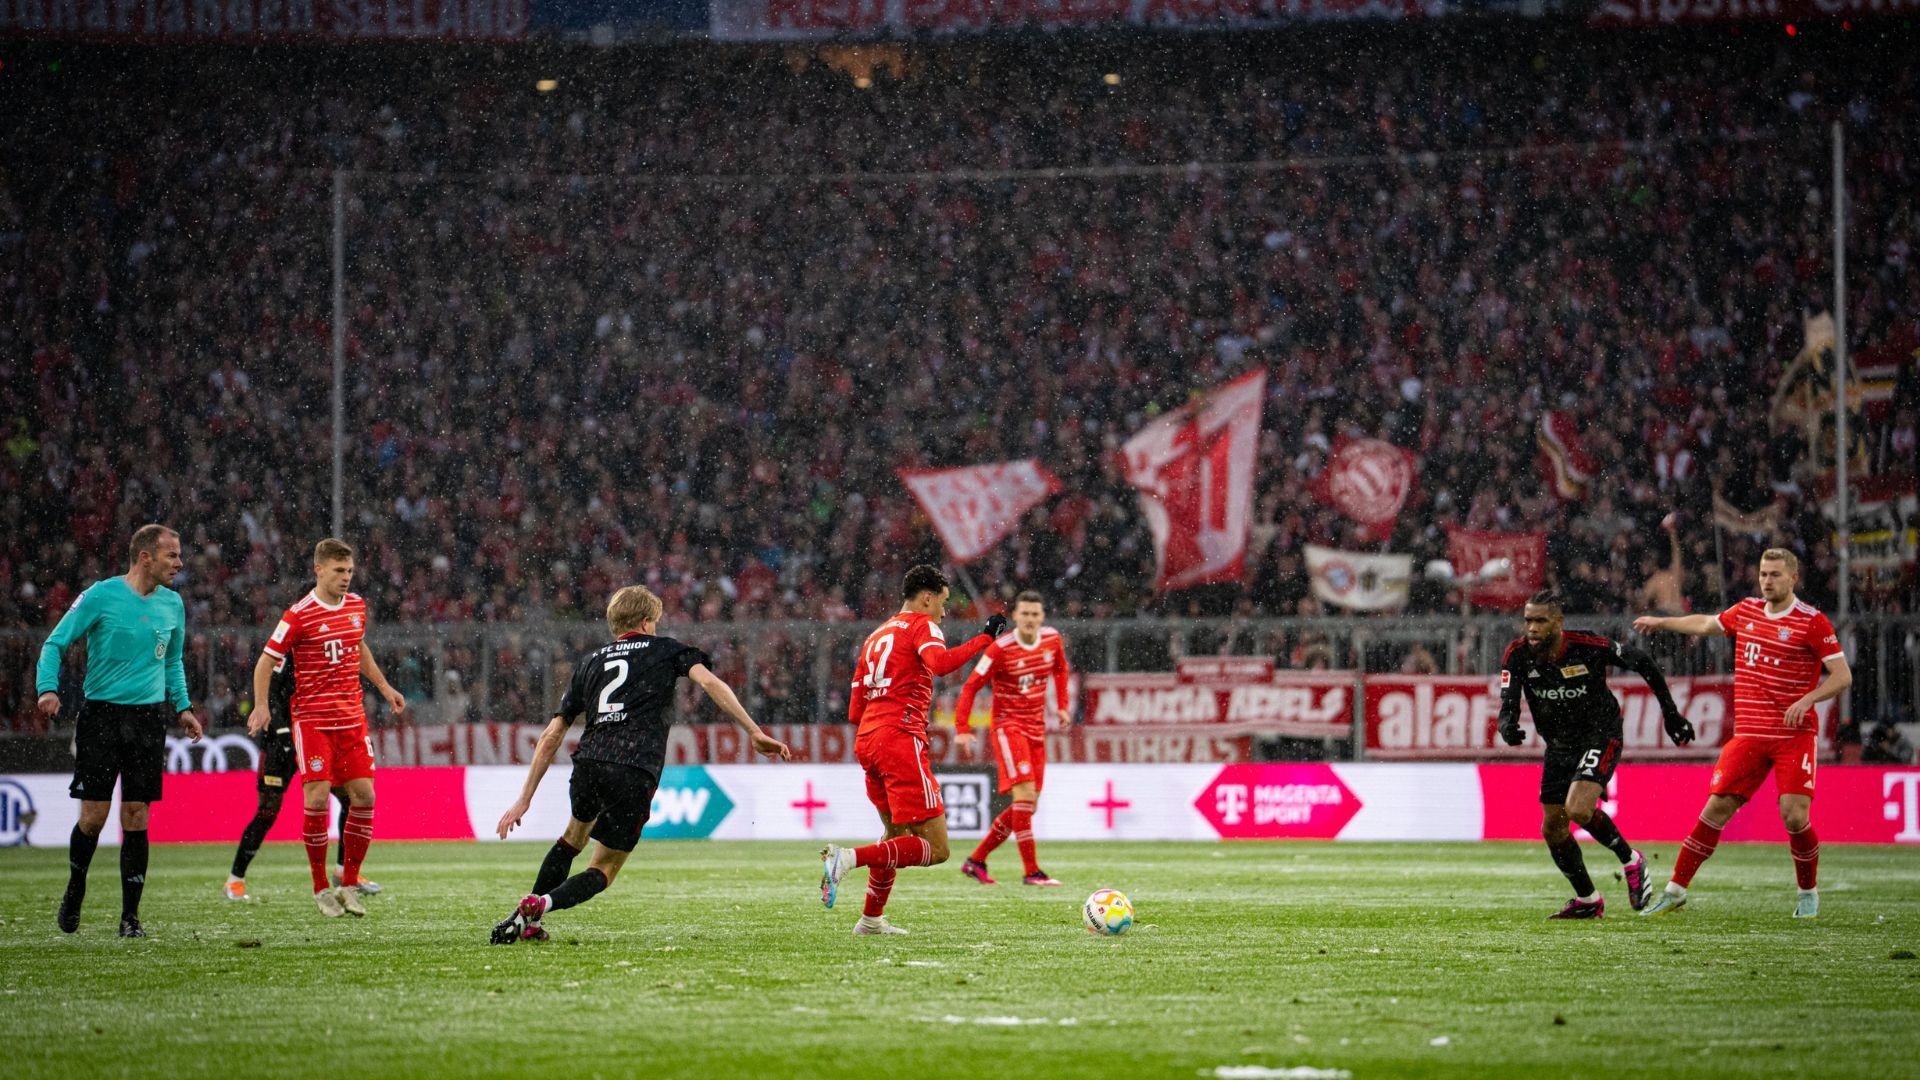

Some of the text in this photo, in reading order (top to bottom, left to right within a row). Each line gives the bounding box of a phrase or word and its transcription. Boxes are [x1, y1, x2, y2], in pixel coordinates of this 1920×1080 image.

[601, 645, 613, 655] FC
[616, 641, 650, 651] UNION
[606, 650, 629, 658] BERLIN
[863, 633, 895, 688] 42
[598, 659, 629, 714] 2
[1531, 685, 1587, 700] wefox
[1801, 753, 1812, 774] 4
[1254, 785, 1342, 805] MAGENTA
[1254, 804, 1313, 824] SPORT
